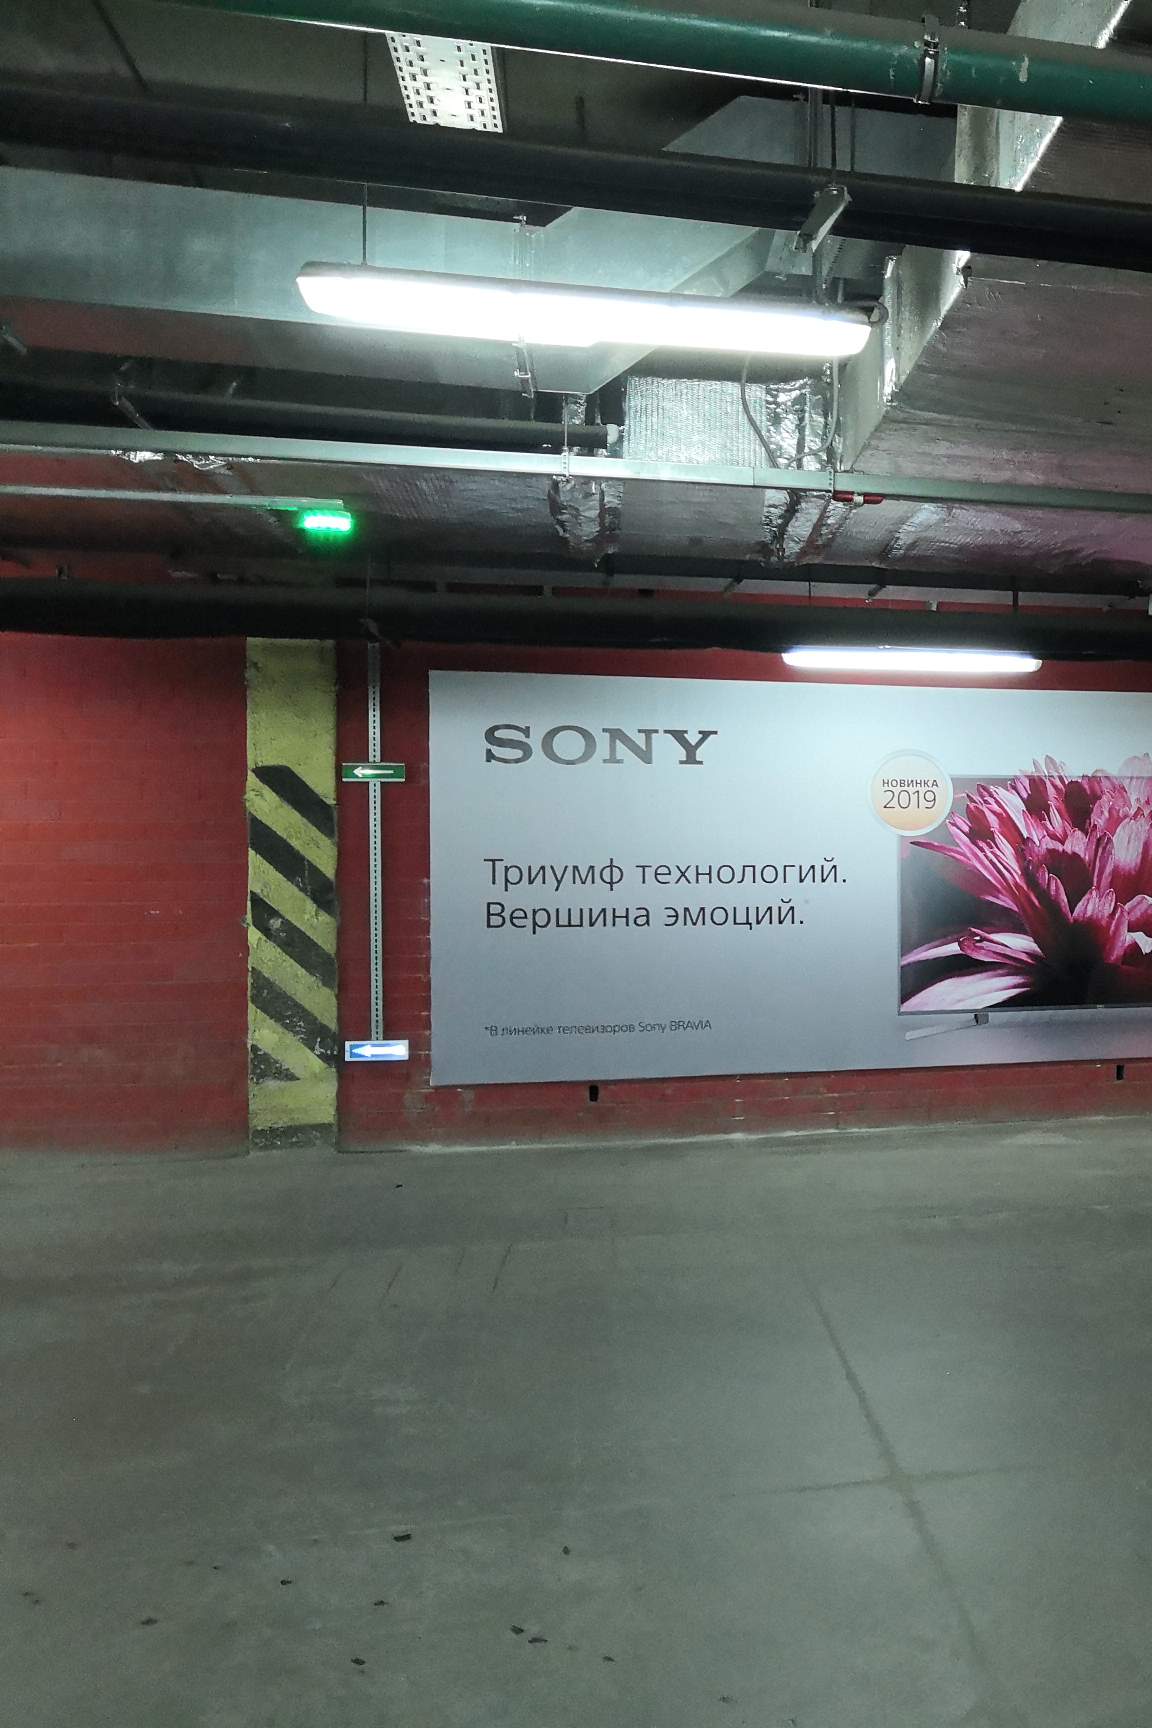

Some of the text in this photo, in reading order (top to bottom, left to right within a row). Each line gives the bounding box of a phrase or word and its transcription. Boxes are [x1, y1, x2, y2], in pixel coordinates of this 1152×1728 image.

[484, 724, 718, 766] SONY
[882, 779, 939, 788] НОВИНКА
[883, 789, 937, 809] 2019
[483, 857, 848, 892] Триумф технологий.
[485, 898, 805, 935] Вершина эмоций.
[501, 1024, 554, 1037] линейке
[557, 1022, 635, 1036] телевизоров
[638, 1021, 666, 1034] Sony
[670, 1019, 713, 1032] BRAVIA
